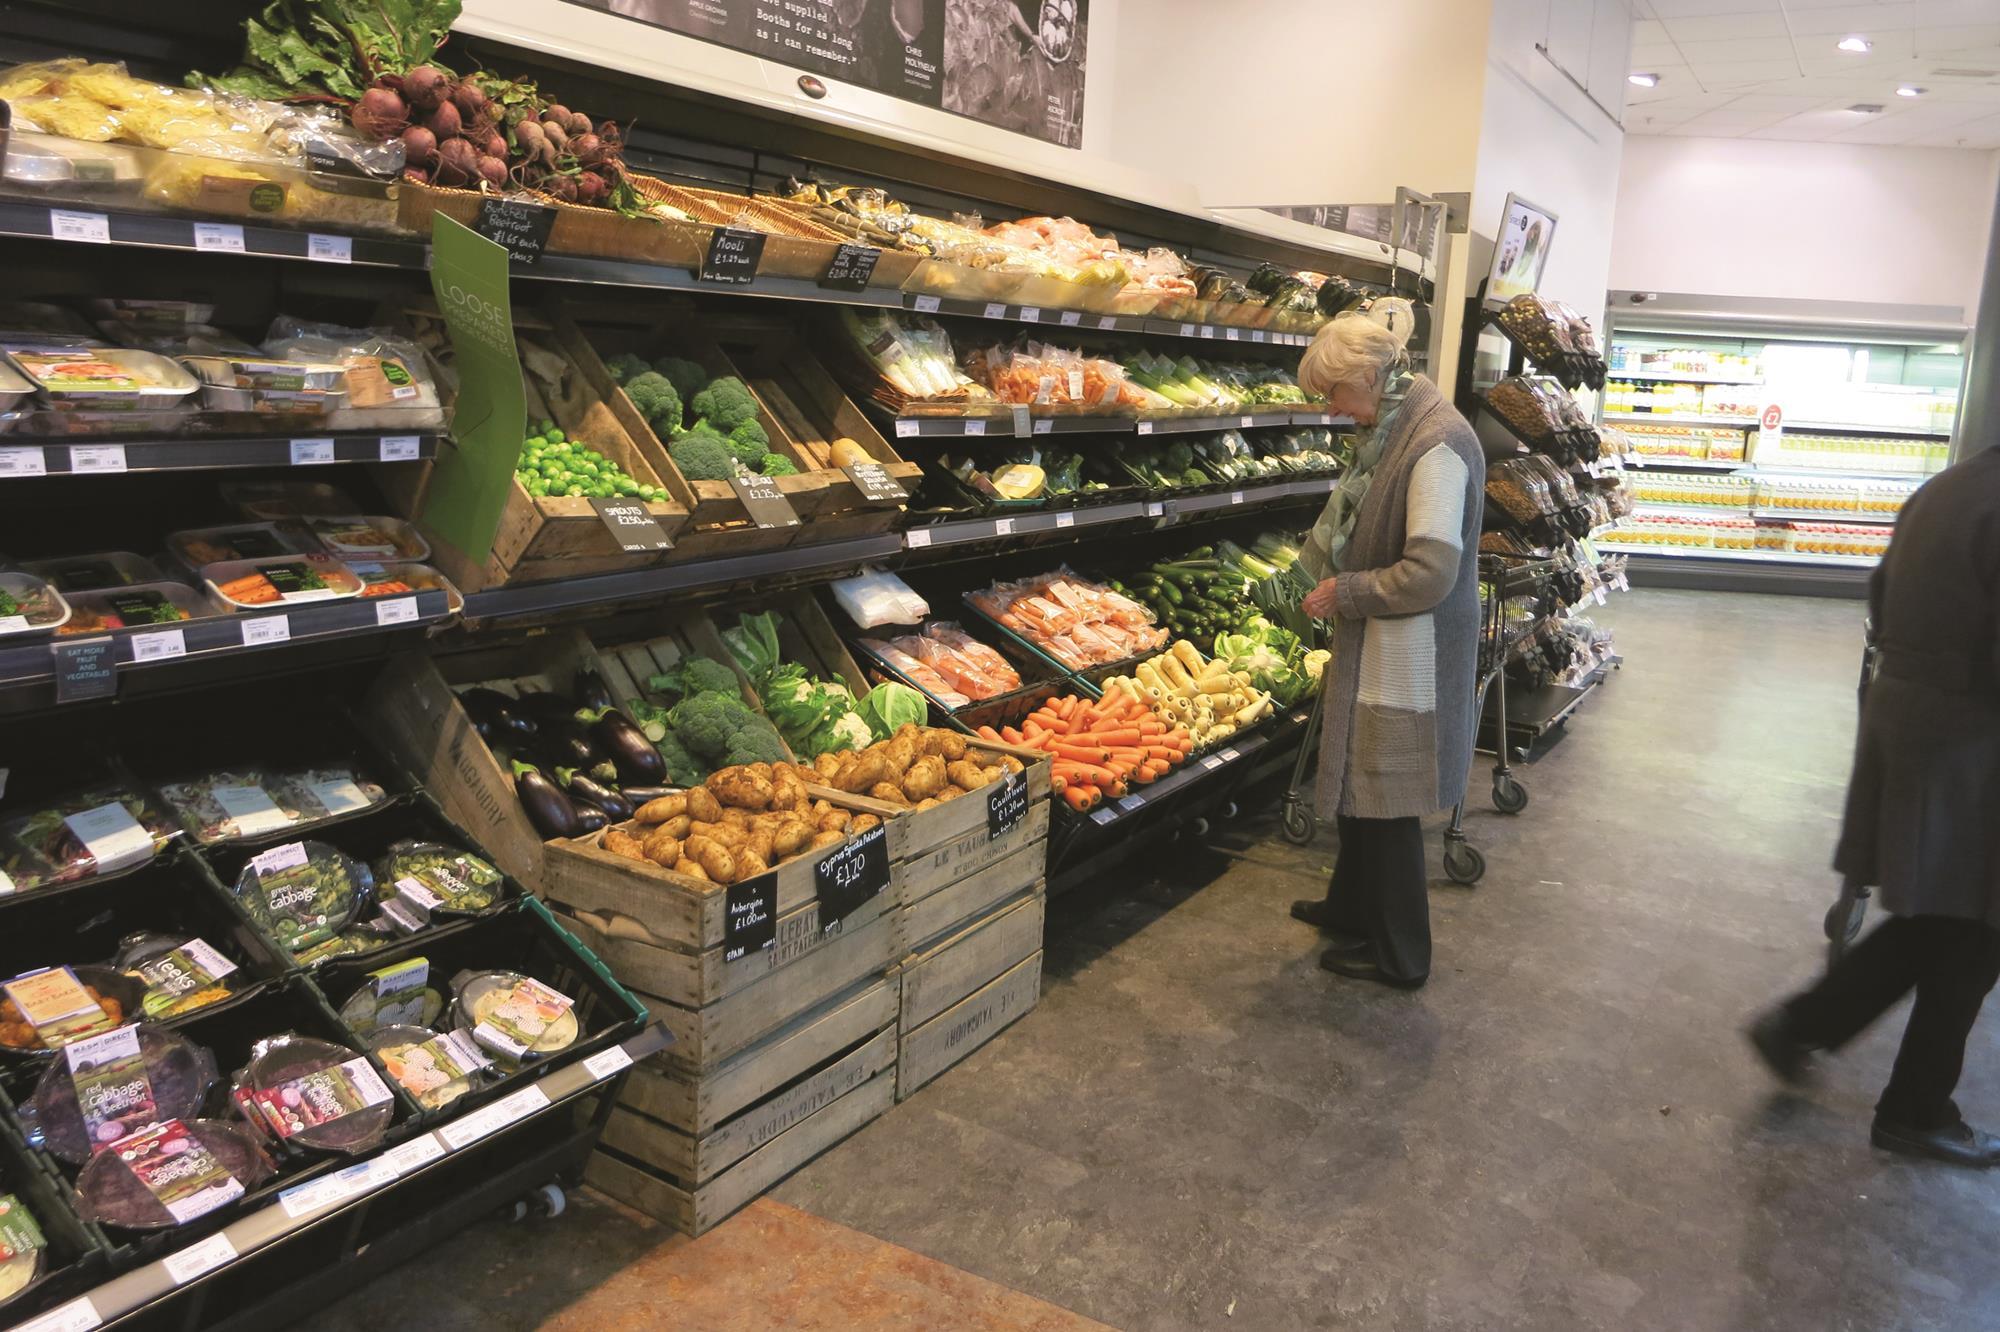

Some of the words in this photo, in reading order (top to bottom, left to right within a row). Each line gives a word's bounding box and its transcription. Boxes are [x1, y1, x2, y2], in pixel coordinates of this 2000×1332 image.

[784, 2, 828, 22] supplied
[756, 8, 791, 28] Booths
[795, 21, 812, 34] for
[816, 30, 828, 40] as
[831, 33, 853, 51] long
[756, 28, 769, 40] as
[774, 32, 780, 43] I
[784, 38, 802, 50] can
[905, 45, 923, 58] CHRIS
[717, 236, 745, 251] Mooli
[440, 279, 504, 327] LOOSE
[605, 506, 642, 516] SPROUTS
[68, 648, 82, 657] EAT
[84, 646, 105, 656] MORE
[66, 669, 110, 680] VEGETABLES
[79, 663, 97, 671] AND
[270, 884, 292, 898] green
[270, 886, 318, 910] cabbage
[731, 899, 764, 915] Aubergine
[727, 946, 745, 961] SPAIN
[156, 957, 196, 989] leeks
[73, 1042, 98, 1053] MASH
[104, 1032, 130, 1044] DIRECT
[86, 1082, 102, 1095] red
[89, 1080, 144, 1105] cabbage
[313, 1078, 343, 1114] cabbage
[104, 1093, 147, 1114] beetroot
[152, 1158, 207, 1186] cabbage
